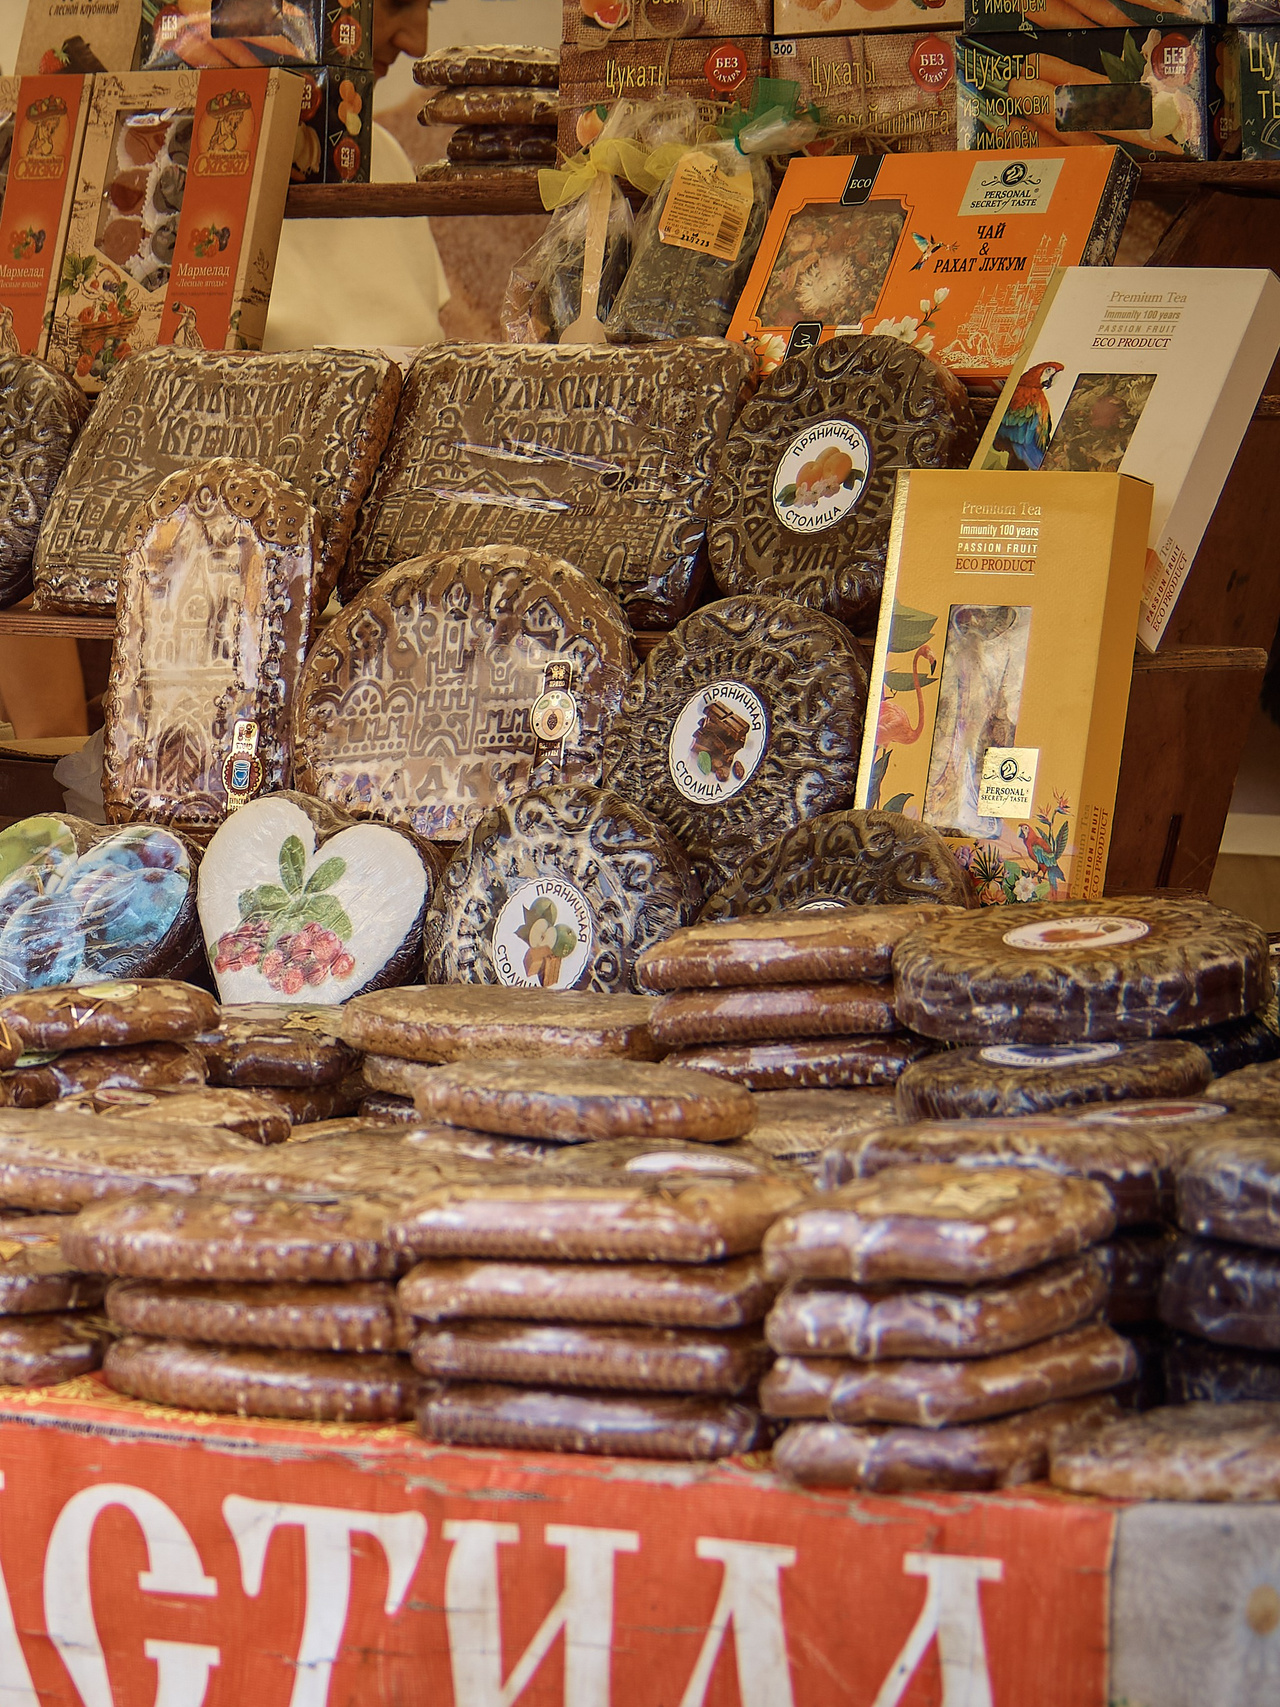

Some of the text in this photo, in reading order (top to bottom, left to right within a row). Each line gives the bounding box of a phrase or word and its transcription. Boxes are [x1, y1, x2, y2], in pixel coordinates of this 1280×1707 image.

[162, 16, 178, 31] БЕЗ
[339, 24, 350, 44] БЕЗ
[715, 57, 739, 69] БЕЗ
[920, 54, 945, 68] БЕЗ
[1163, 47, 1187, 64] БЕЗ
[715, 67, 741, 83] САХАРА
[811, 56, 877, 96] Цукаты
[918, 66, 948, 84] САХАРА
[964, 48, 1040, 90] Цукаты
[605, 60, 669, 98] Цукаты
[964, 96, 1050, 125] из моркови
[340, 147, 350, 168] БЕЗ
[849, 178, 872, 189] ECO
[984, 190, 1031, 199] PERSONAL
[970, 200, 1002, 208] SECRET
[1010, 199, 1037, 207] TASTE
[977, 222, 1007, 240] ЧАЙ
[979, 243, 990, 256] &
[177, 263, 230, 280] Мармелад
[934, 257, 1027, 273] РАХАТ ЛУКУМ
[1109, 291, 1187, 303] Premium Tea
[1104, 309, 1181, 321] Immunity 100 years
[1098, 325, 1176, 333] PASSION FRUIT
[1092, 338, 1171, 348] ECO PRODUCT
[792, 427, 859, 457] ПРЯНИЧНАЯ
[785, 506, 841, 527] СТОЛИЦА
[963, 501, 1041, 516] Premium Tea
[960, 524, 1039, 538] Immunity 100 years
[957, 543, 1038, 554] PASSION FRUIT
[1160, 536, 1174, 557] Tea
[955, 558, 1035, 572] ECO PRODUCT
[1146, 545, 1181, 623] PASSION FRUIT
[1152, 553, 1188, 632] ECO PRODUCT
[702, 687, 761, 731] ПРЯНИЧНАЯ
[676, 760, 722, 797] СТОЛИЦА
[985, 786, 1025, 796] PERSONAL
[1095, 808, 1109, 871] PRODUCT
[1083, 806, 1100, 899] PASSION FRUIT
[535, 883, 588, 943] ПРЯНИЧНАЯ
